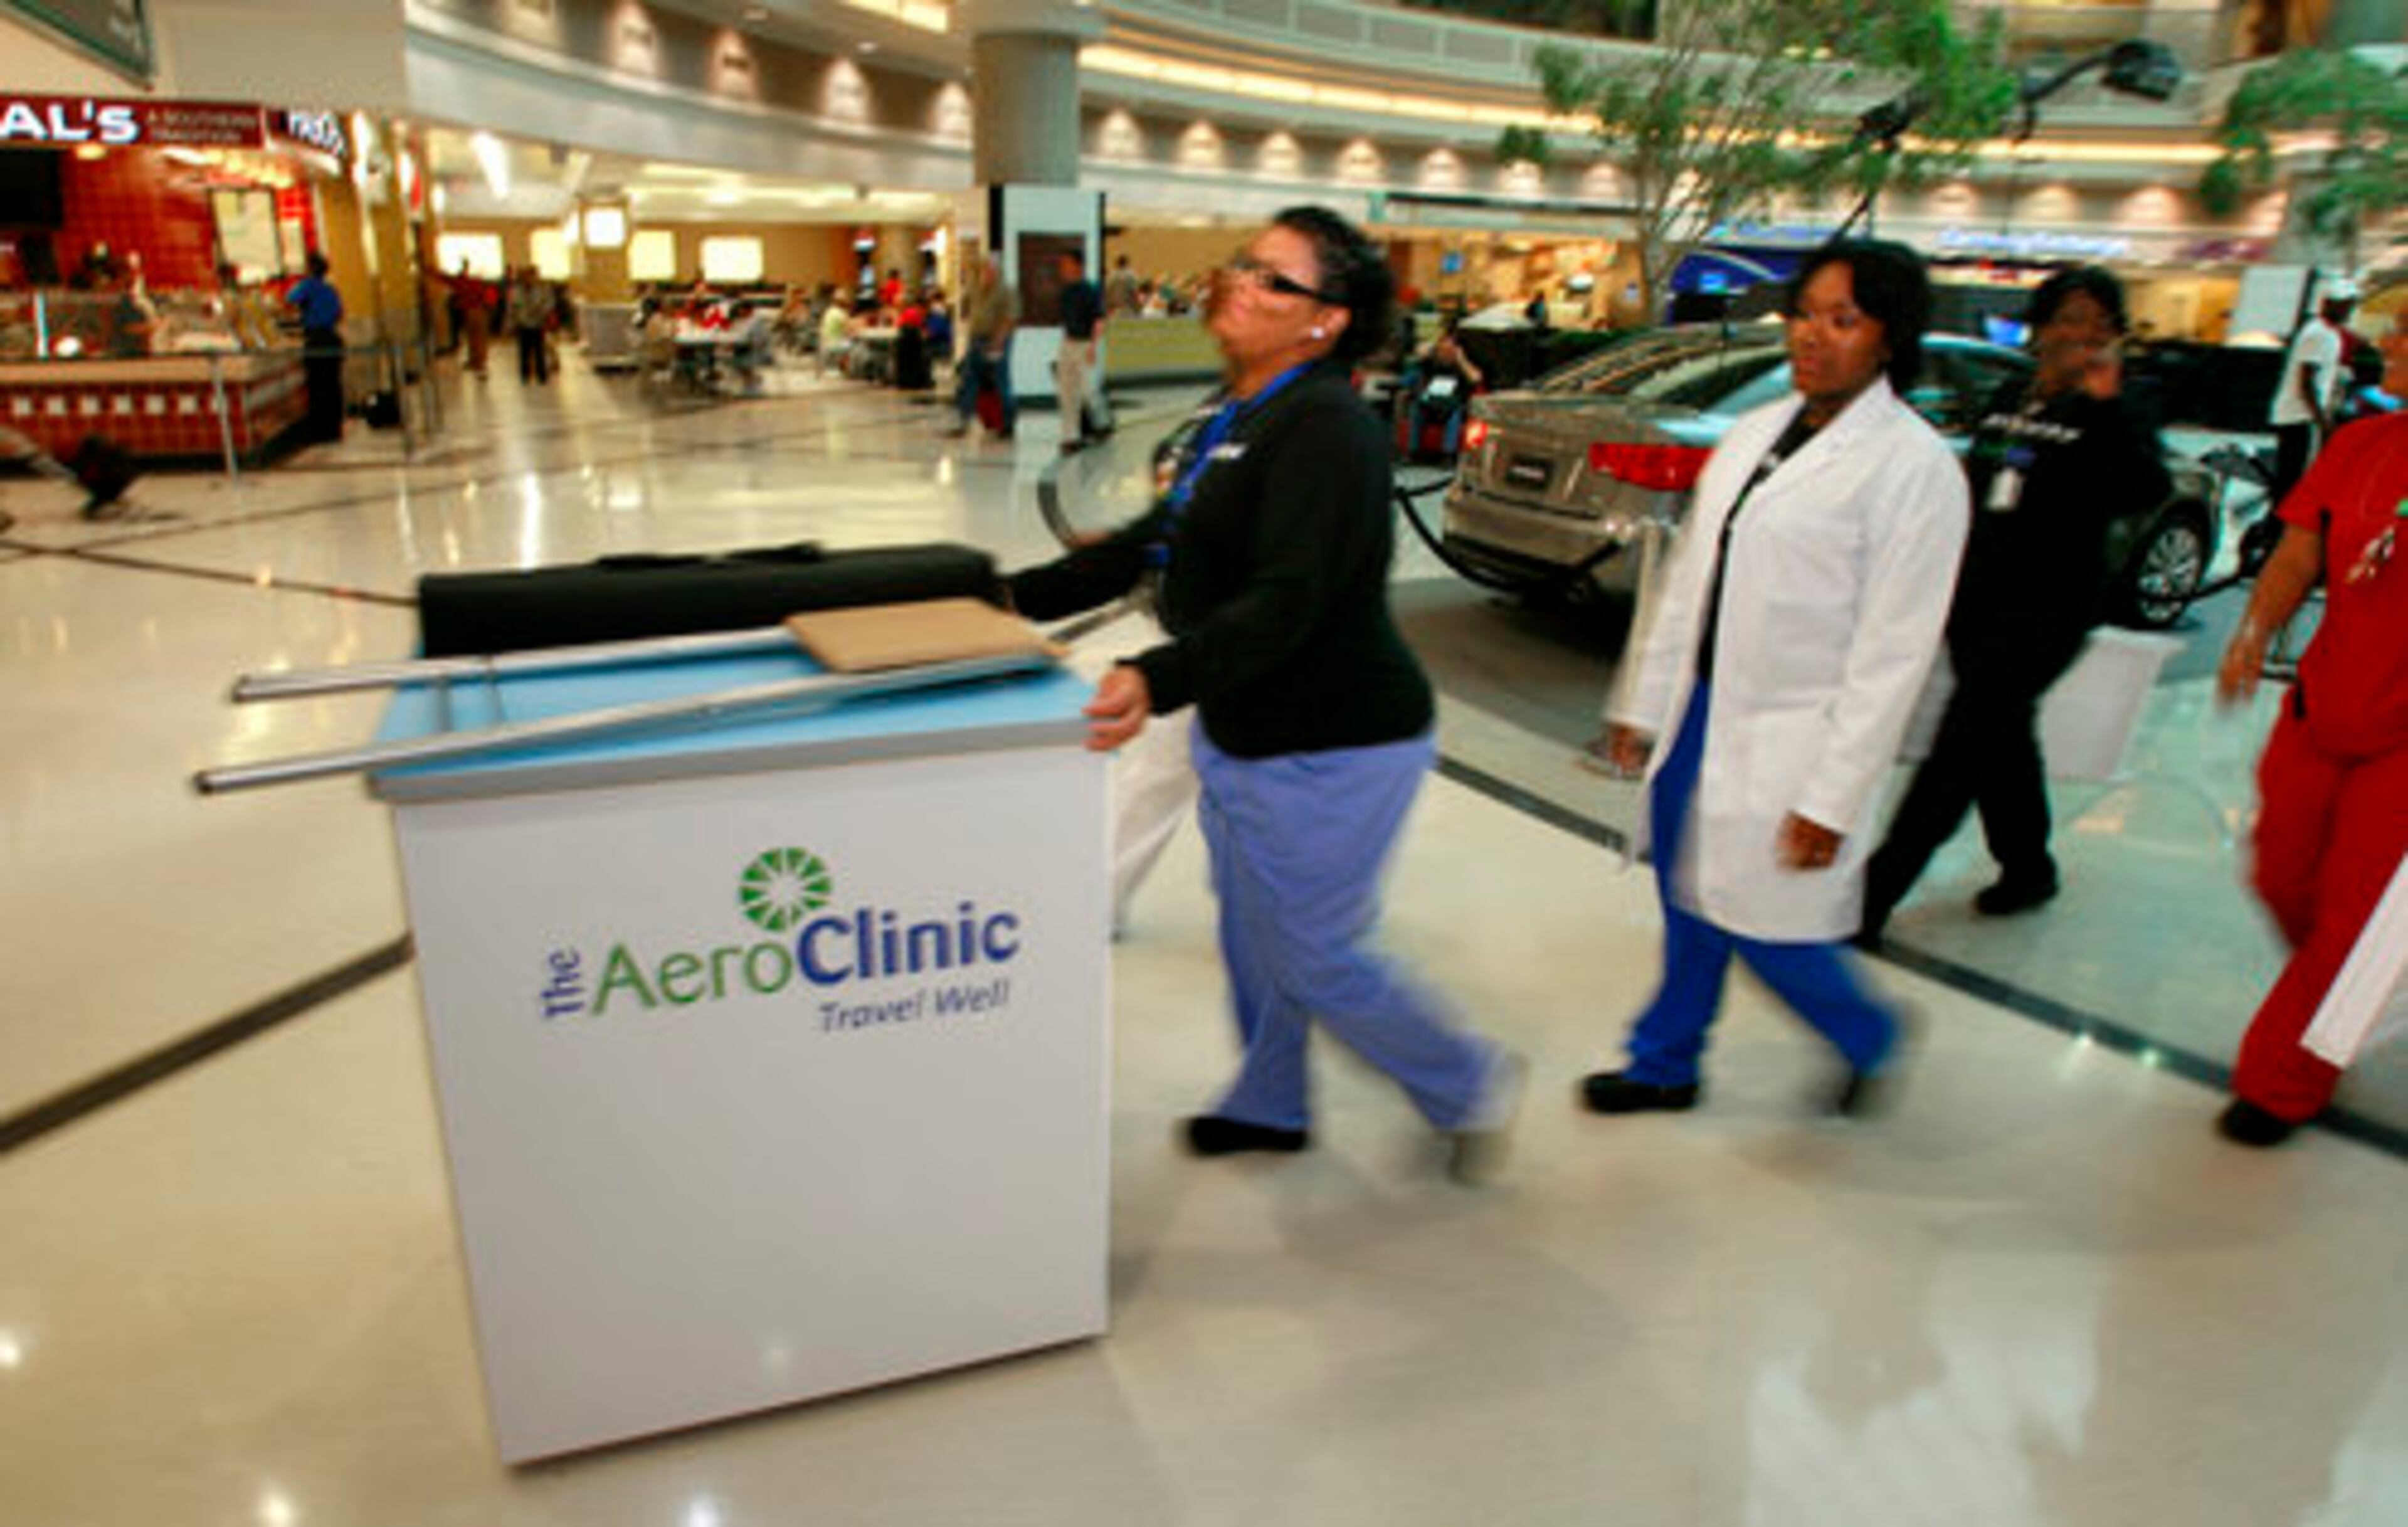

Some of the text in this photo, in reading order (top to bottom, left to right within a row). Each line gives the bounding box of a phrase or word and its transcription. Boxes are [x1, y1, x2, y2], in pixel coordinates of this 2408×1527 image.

[0, 100, 139, 144] AL'S
[541, 901, 1020, 1020] The AeroClinic
[818, 978, 1011, 1033] Travel Well
